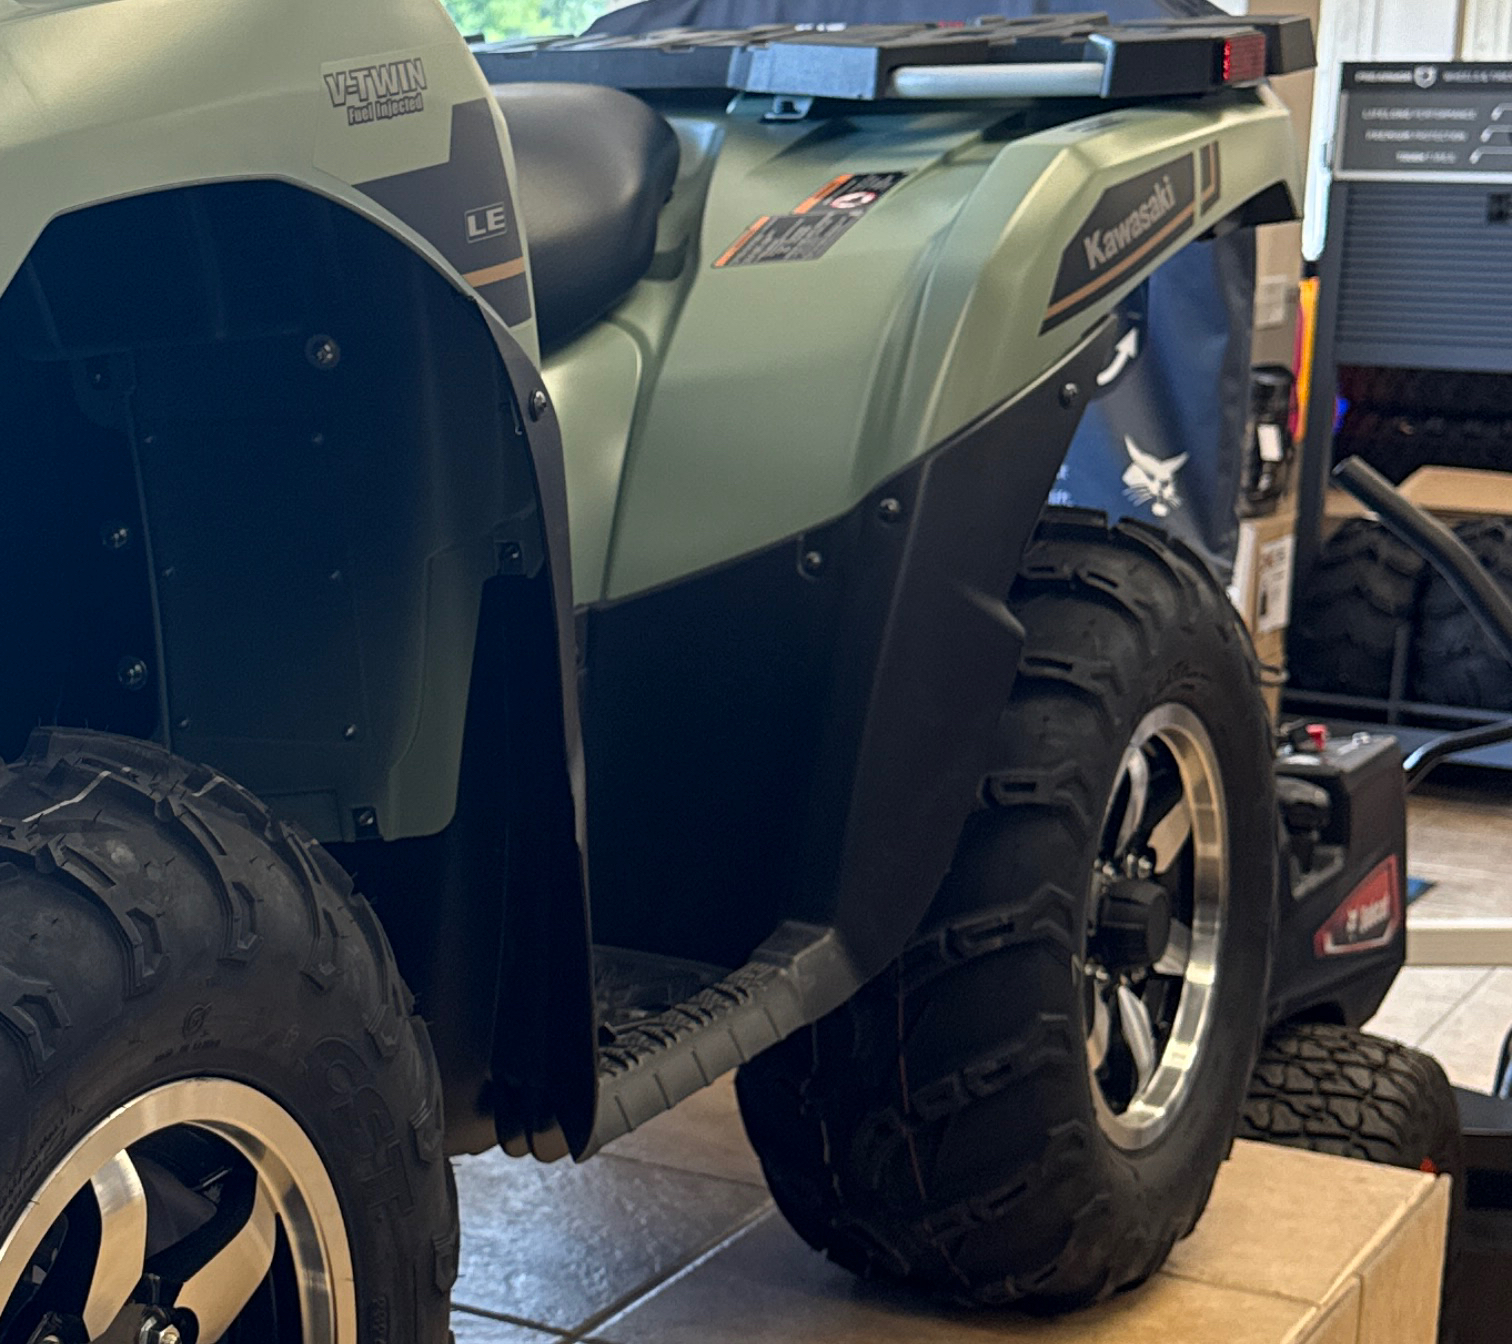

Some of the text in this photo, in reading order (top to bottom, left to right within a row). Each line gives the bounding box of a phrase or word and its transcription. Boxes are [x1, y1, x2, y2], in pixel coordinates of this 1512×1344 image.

[323, 57, 427, 108] V-TWIN
[347, 102, 375, 126] Fuel
[467, 206, 506, 237] LE
[1083, 174, 1176, 271] Kawasaki
